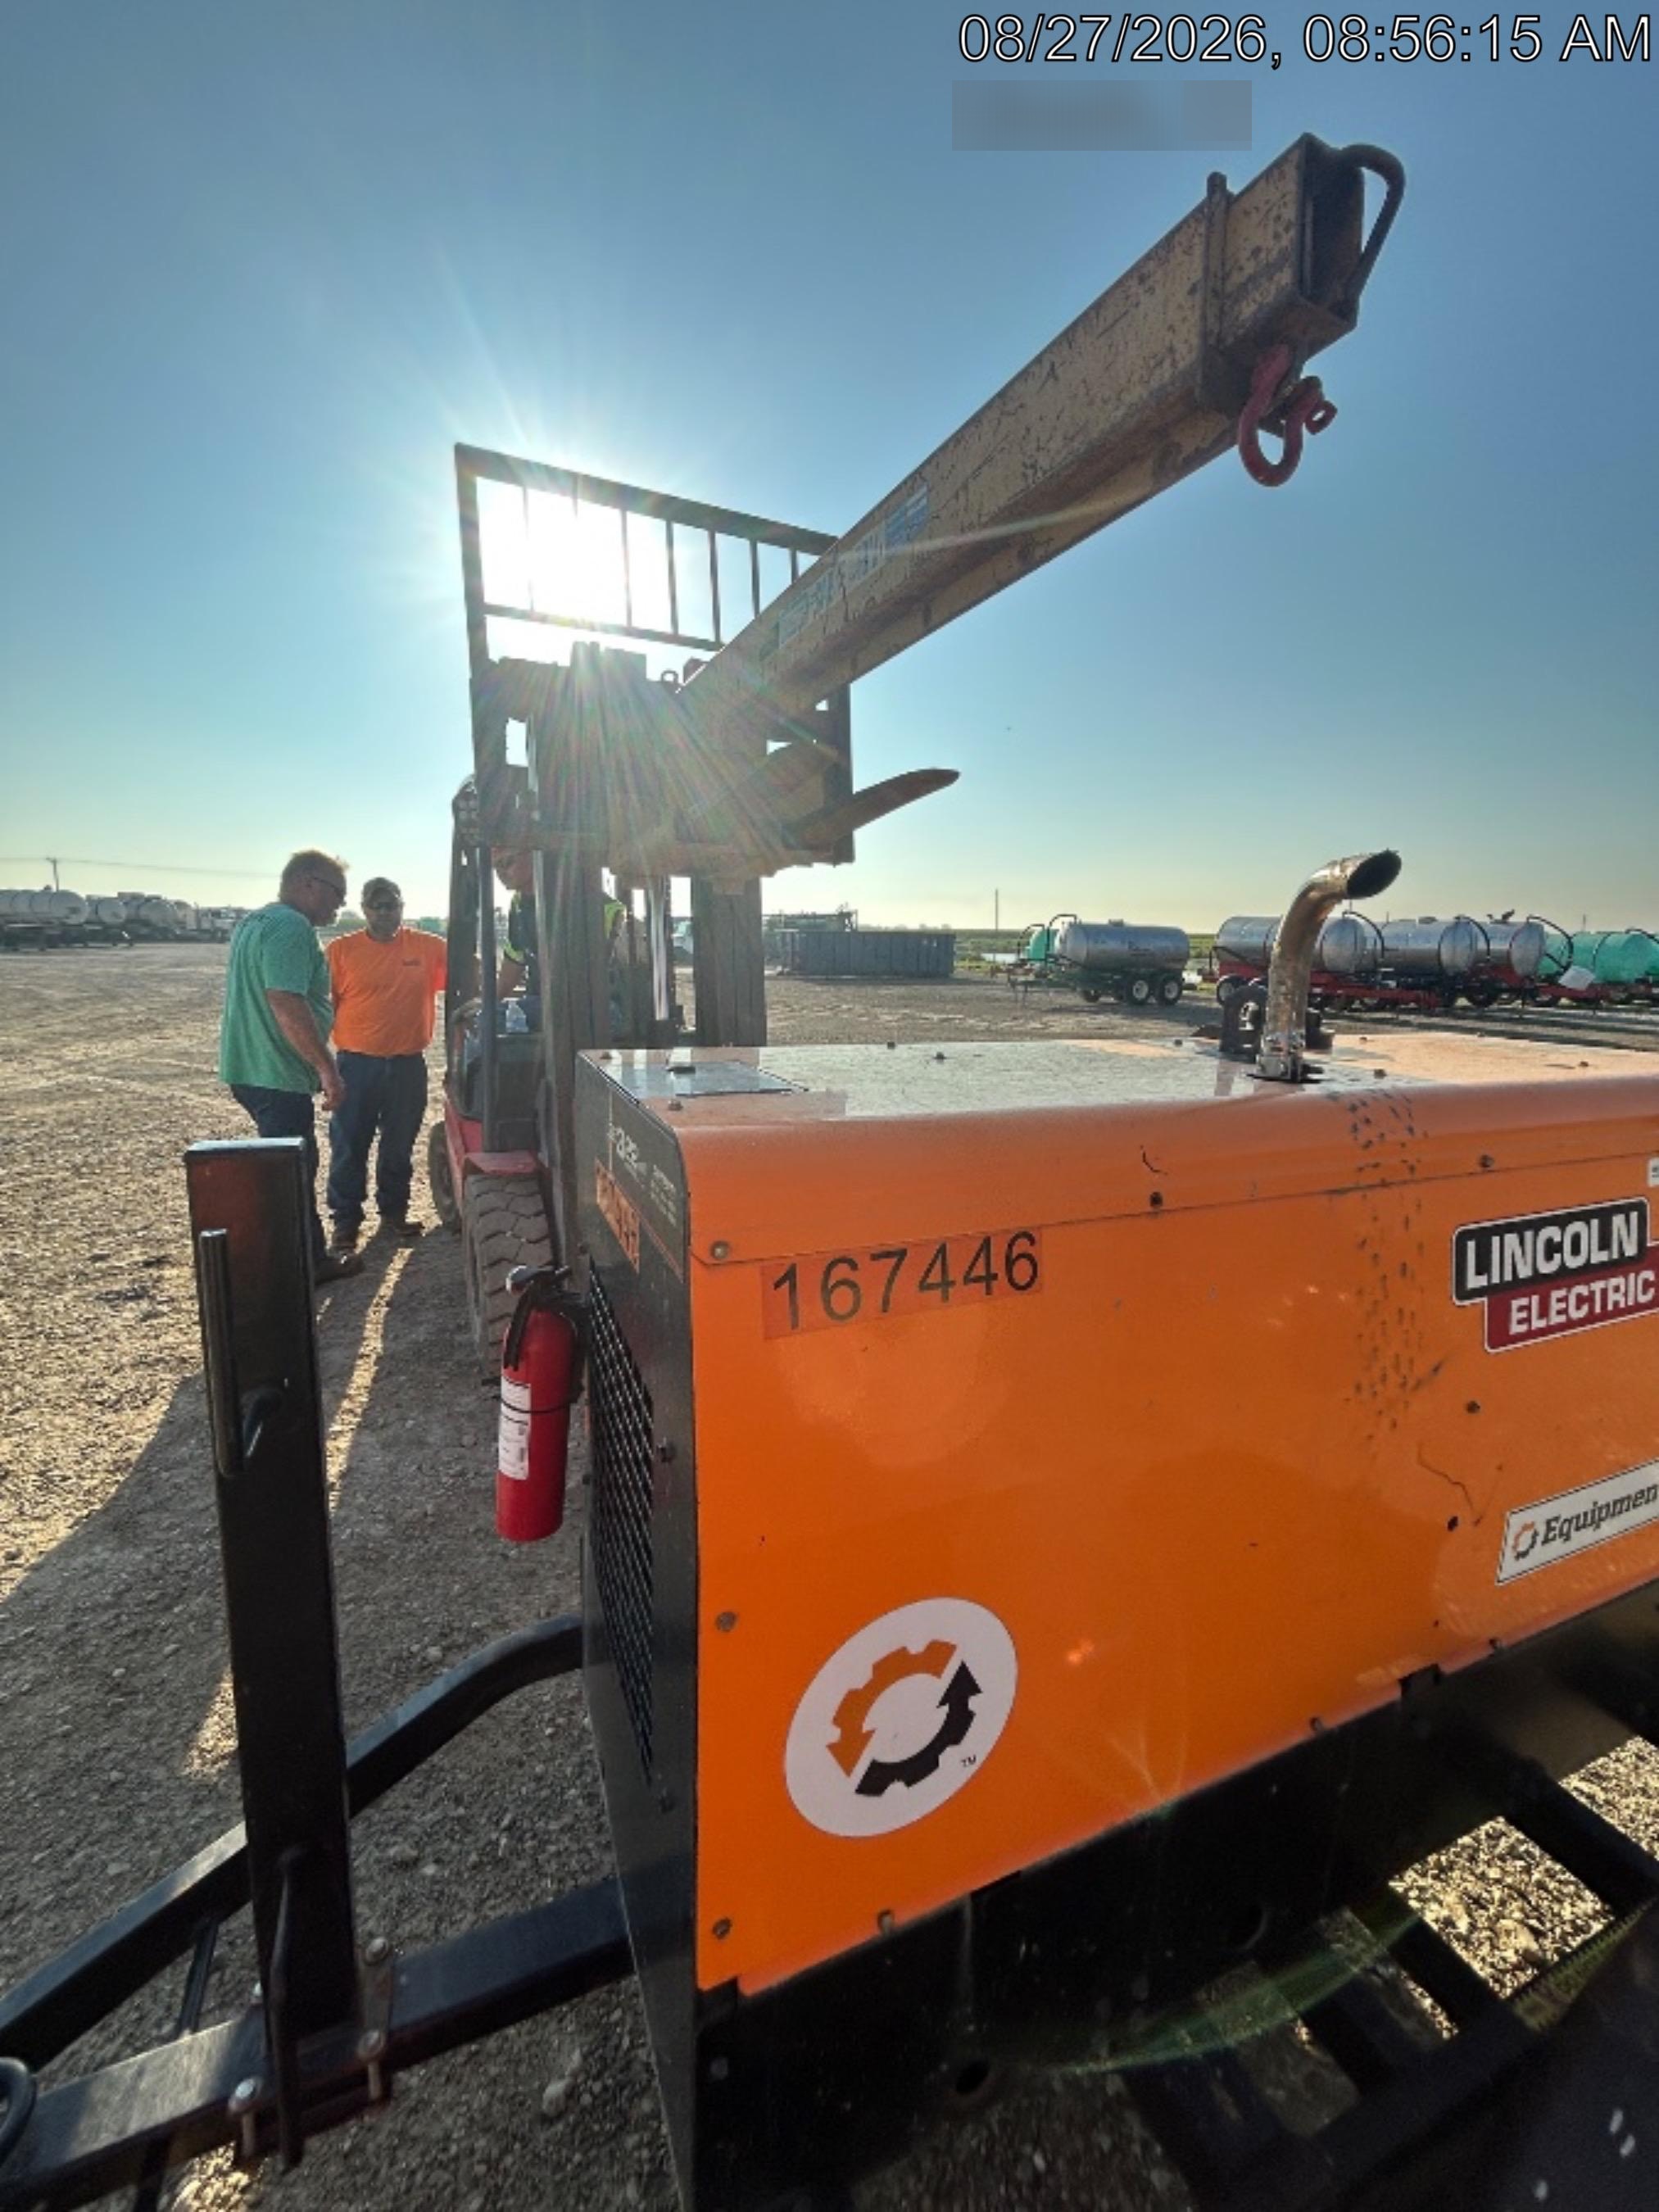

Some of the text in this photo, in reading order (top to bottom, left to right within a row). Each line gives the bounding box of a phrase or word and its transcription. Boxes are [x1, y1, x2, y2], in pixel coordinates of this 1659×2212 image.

[773, 1231, 1039, 1331] 167446
[1466, 1210, 1639, 1290] LINCOLN
[1508, 1269, 1656, 1336] ELECTRIC
